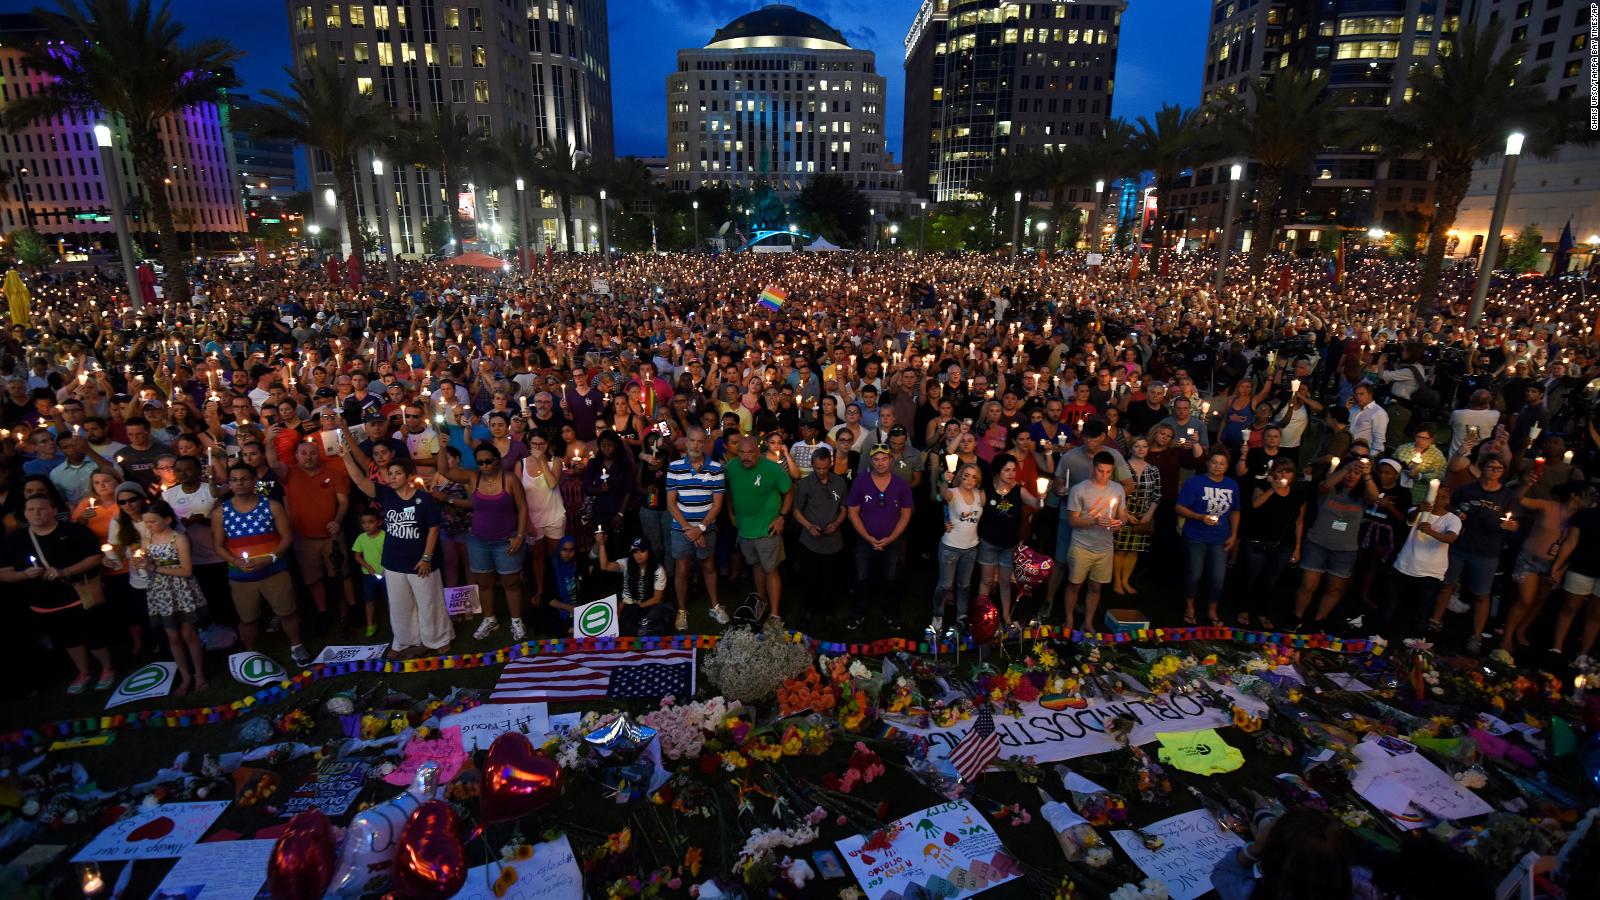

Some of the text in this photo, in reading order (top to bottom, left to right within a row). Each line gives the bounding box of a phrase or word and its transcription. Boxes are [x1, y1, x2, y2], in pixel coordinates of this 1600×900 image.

[1202, 486, 1233, 503] JUST
[386, 509, 416, 522] RISING
[451, 591, 470, 600] LOVE
[449, 601, 468, 609] HAT
[926, 800, 969, 818] Sorry
[92, 835, 184, 856] Always in our
